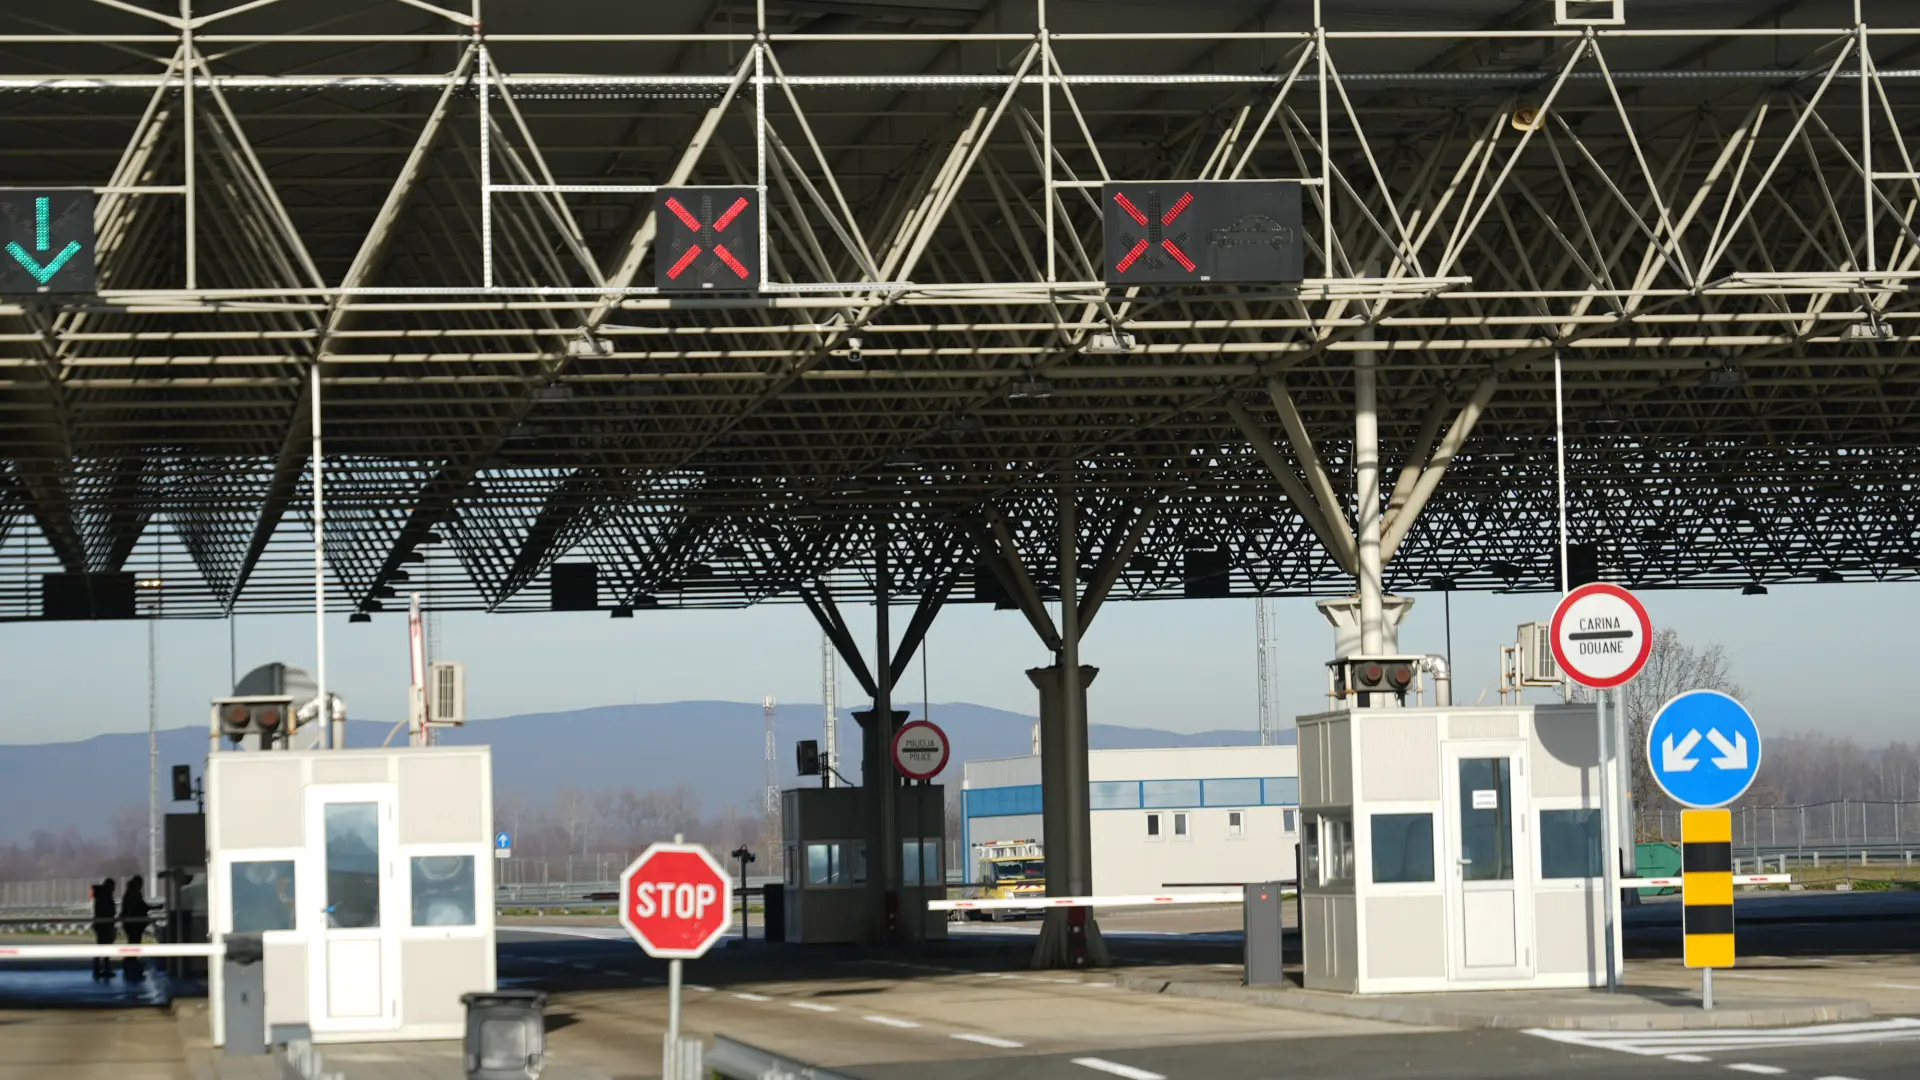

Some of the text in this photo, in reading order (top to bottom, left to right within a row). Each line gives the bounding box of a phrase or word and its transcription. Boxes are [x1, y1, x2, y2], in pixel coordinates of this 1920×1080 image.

[1579, 616, 1621, 631] CARINA
[1579, 640, 1624, 655] DOUANE
[905, 739, 935, 748] POLICIJA
[909, 753, 931, 761] POLICE
[636, 881, 717, 920] STOP
